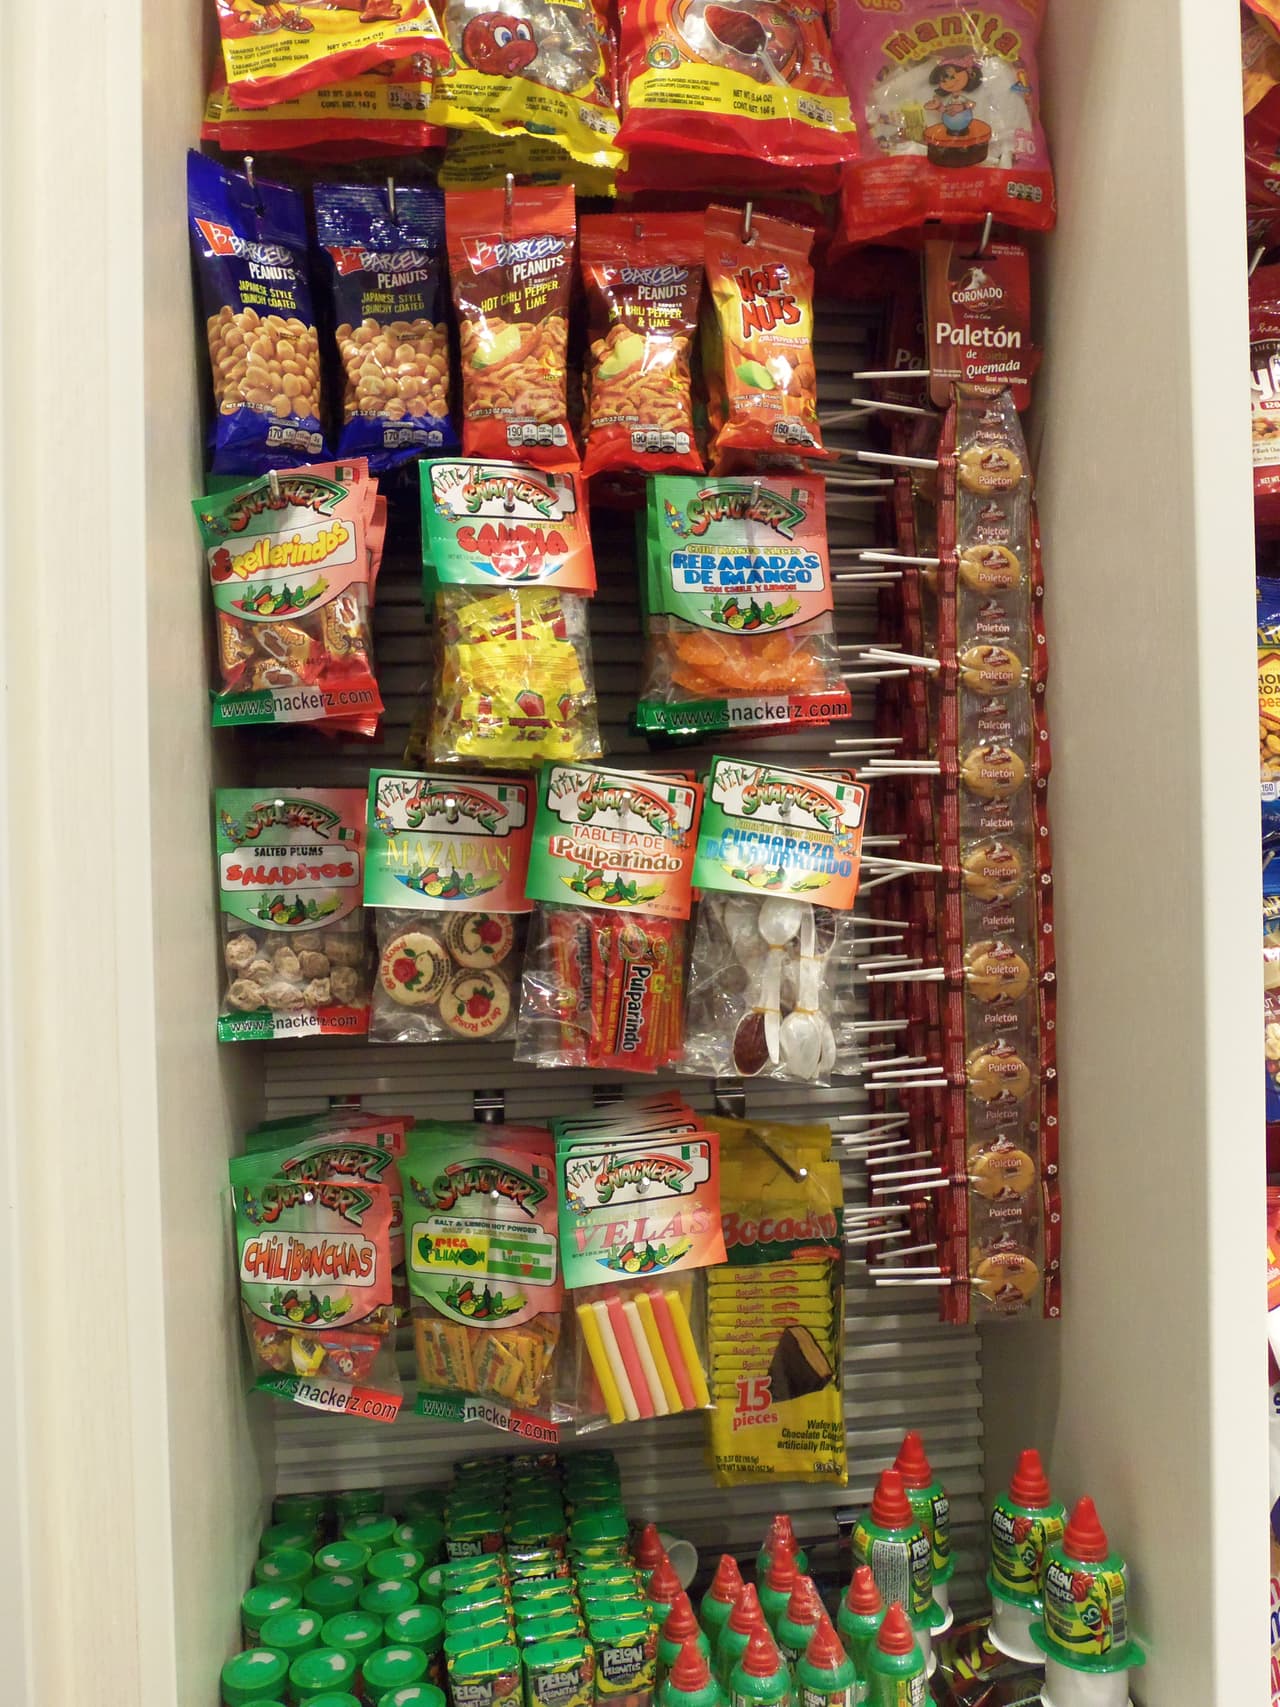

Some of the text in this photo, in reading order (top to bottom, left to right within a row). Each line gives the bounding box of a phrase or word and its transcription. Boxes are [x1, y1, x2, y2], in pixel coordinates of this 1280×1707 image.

[493, 236, 566, 266] BARCEL
[248, 261, 296, 280] PEANUTS
[360, 250, 429, 272] BARCEL
[512, 255, 565, 284] PEANUTS
[377, 269, 428, 289] PEANUTS
[620, 265, 689, 287] BARCEL
[734, 263, 789, 303] HOT
[269, 288, 294, 300] STYLE
[361, 291, 424, 304] JAPANESE STYLE
[481, 281, 559, 312] HOT CHILI PEPPER
[637, 284, 688, 301] PEANUTS
[952, 287, 1004, 304] CORONADO
[268, 297, 297, 310] COATED
[394, 302, 425, 313] COATED
[513, 294, 548, 315] & LIME
[647, 306, 683, 319] PEPPER
[637, 317, 671, 329] & LIME
[741, 295, 802, 339] NUTS
[936, 322, 1022, 349] Paletón
[966, 349, 978, 359] de
[966, 359, 1021, 379] Quemada
[268, 427, 283, 440] 170
[384, 430, 399, 441] 170
[507, 426, 522, 437] 190
[631, 432, 647, 443] 190
[774, 423, 789, 434] 160
[231, 521, 351, 580] rellerindos
[672, 553, 820, 571] REBANADAS
[684, 569, 813, 586] DE MANGO
[755, 584, 762, 592] Y
[220, 690, 374, 718] www.snackerz.com
[671, 700, 848, 726] www.snackerz.com
[1261, 783, 1274, 792] 160
[572, 825, 664, 850] TABLETA DE
[720, 827, 835, 860] CUCHARAZO
[254, 846, 324, 857] SALTED PLUMS
[385, 838, 512, 872] MAZAPAN
[555, 837, 682, 871] Pulparindo
[226, 862, 354, 886] SALADITOS
[622, 964, 653, 1052] Pulparindo
[230, 1014, 357, 1033] www.snackerz.com
[434, 1219, 454, 1227] SALT
[464, 1221, 491, 1229] LEMON
[491, 1223, 506, 1231] HOT
[506, 1225, 538, 1235] POWDER
[574, 1207, 712, 1253] VELAS
[434, 1237, 469, 1249] PICA
[735, 1377, 772, 1413] 15
[423, 1399, 558, 1443] www.snackerz.com
[732, 1412, 778, 1432] pieces
[807, 1419, 831, 1430] Wafer
[781, 1427, 820, 1440] Chocolate
[777, 1440, 818, 1453] artificially
[992, 1510, 1015, 1530] PELON
[1047, 1565, 1073, 1590] PELON
[603, 1648, 644, 1665] PELON
[538, 1671, 579, 1692] PELON
[452, 1684, 492, 1700] PELON
